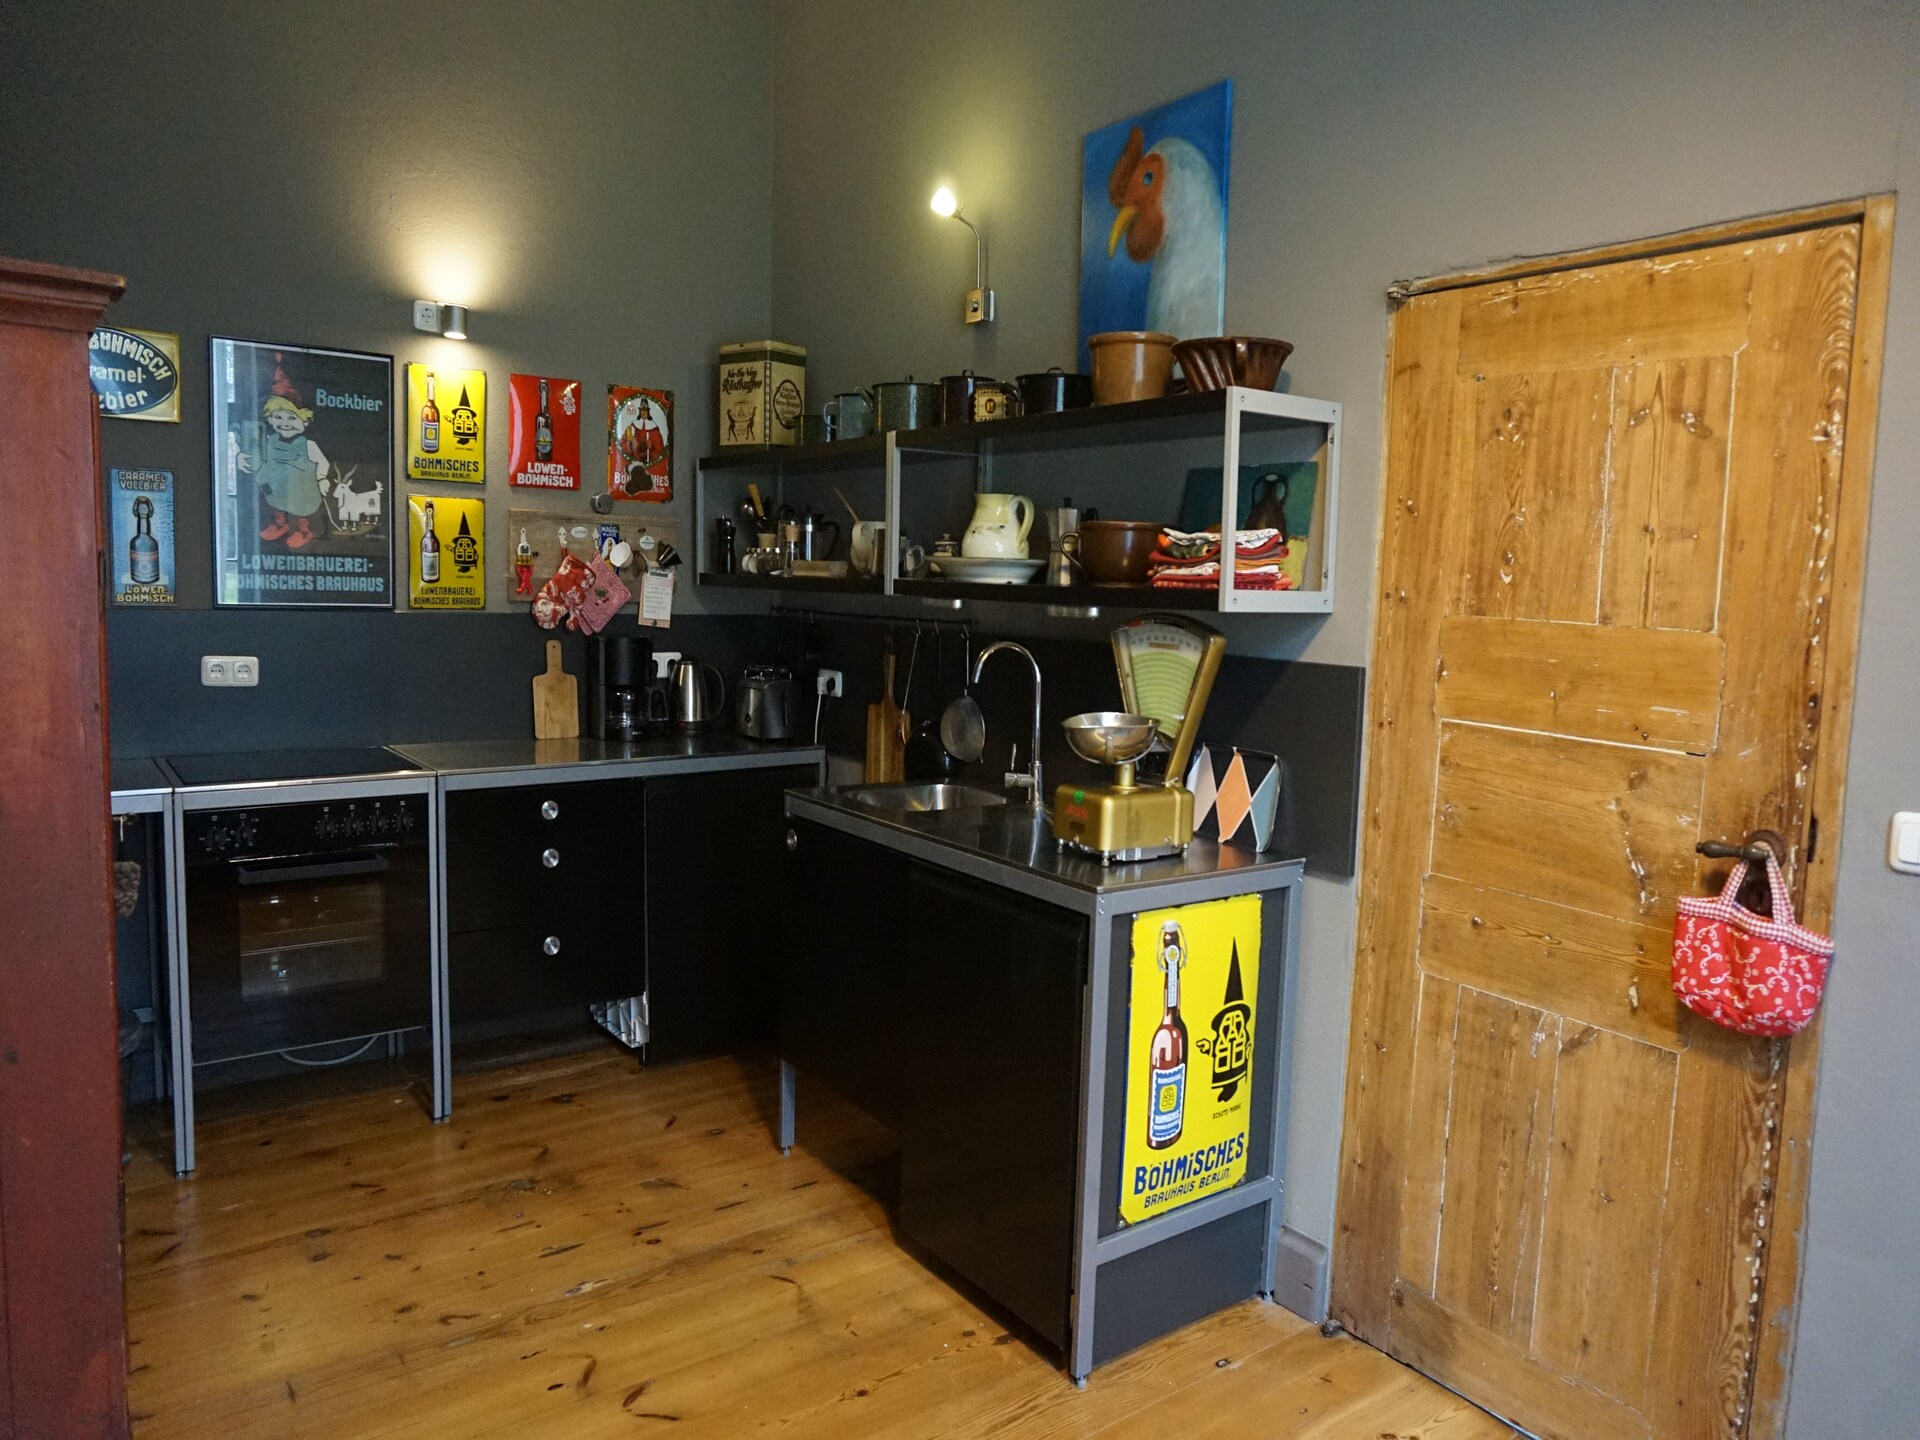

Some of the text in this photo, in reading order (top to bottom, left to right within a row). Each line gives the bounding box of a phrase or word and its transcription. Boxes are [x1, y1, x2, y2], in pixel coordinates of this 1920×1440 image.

[89, 366, 147, 384] ramel-
[316, 388, 383, 412] Bockbier
[118, 471, 166, 482] CARAMEL
[120, 480, 166, 491] VOLLBIER
[316, 576, 384, 592] BRAUHAUS
[1144, 1180, 1195, 1209] BRAUHAUS
